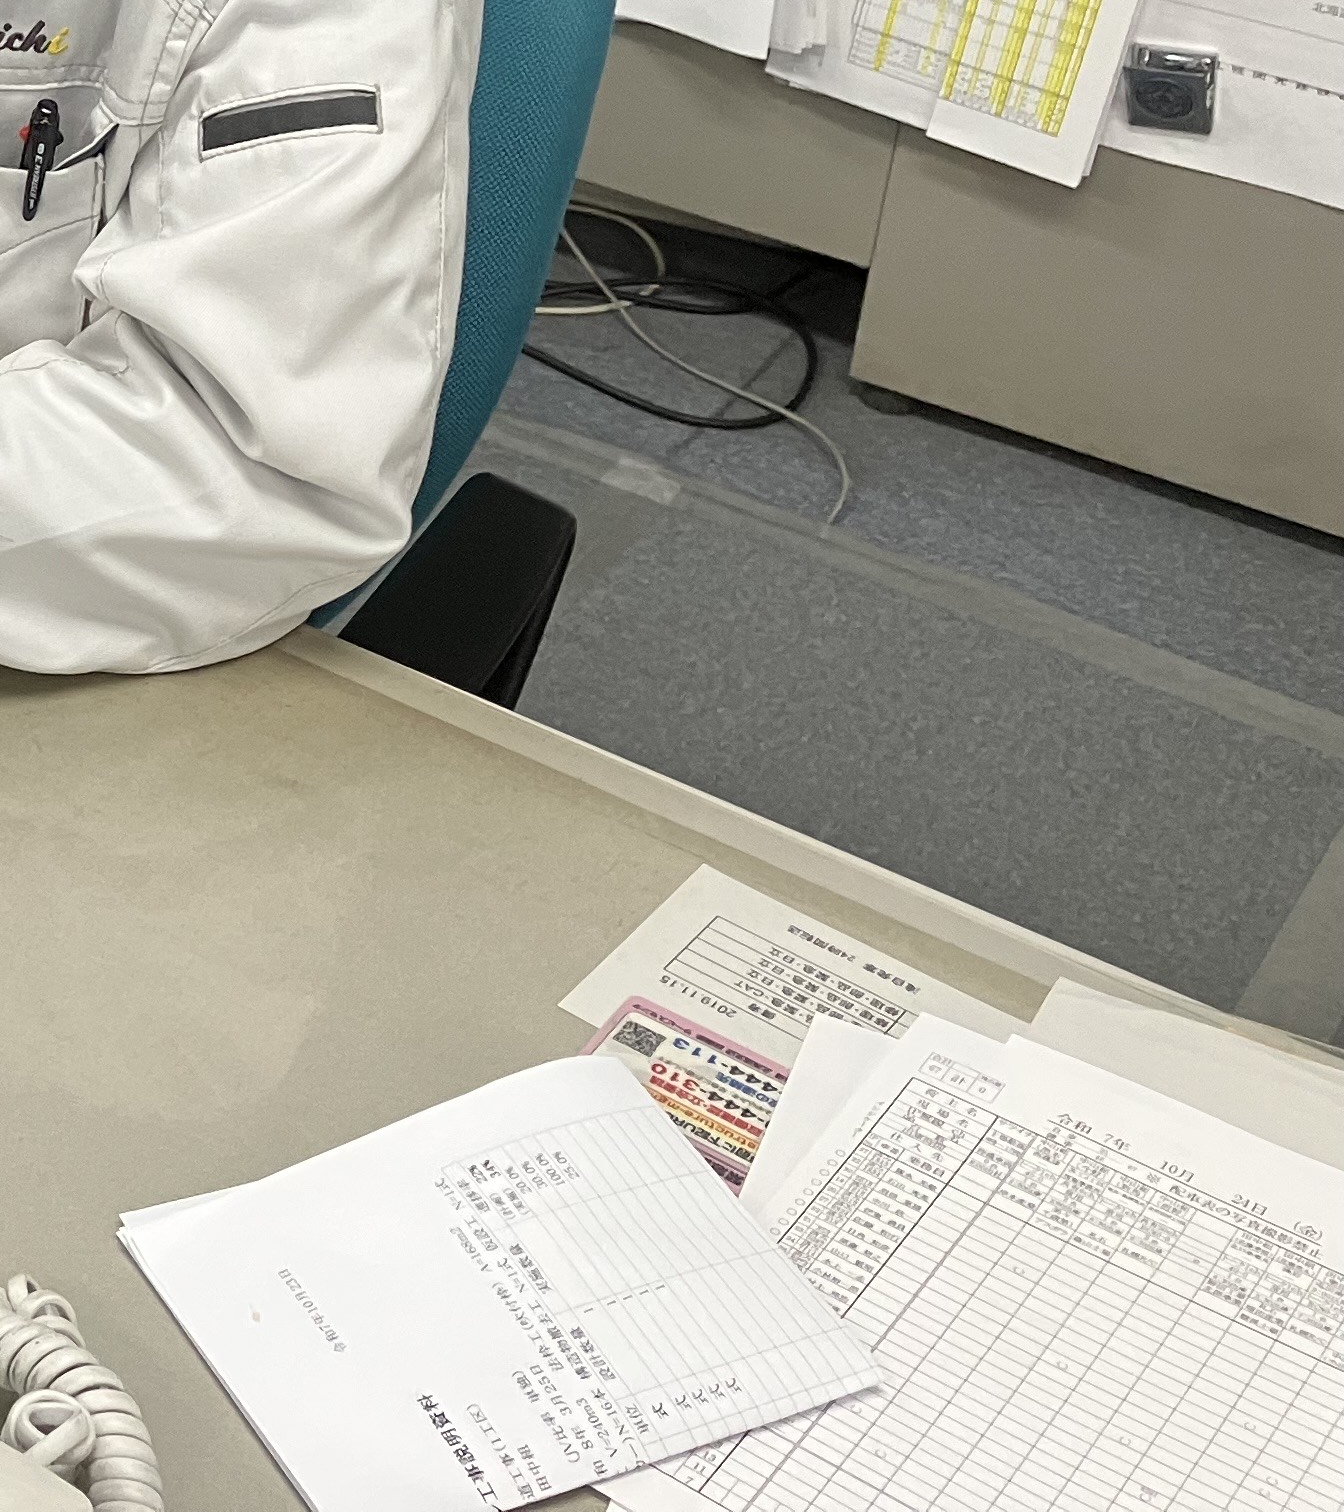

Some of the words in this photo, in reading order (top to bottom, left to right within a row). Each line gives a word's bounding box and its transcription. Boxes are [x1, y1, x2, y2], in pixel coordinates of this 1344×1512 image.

[658, 973, 737, 1019] 2019.11.15
[1054, 1109, 1094, 1138] 令和
[1157, 1157, 1195, 1184] 10月
[1229, 1192, 1268, 1218] 24日
[276, 1265, 348, 1355] 令和7年10月23日
[527, 1360, 574, 1419] 3月25日
[622, 1401, 652, 1436] 単位
[414, 1389, 509, 1512] 工事説明資料
[514, 1441, 555, 1494] 田中組
